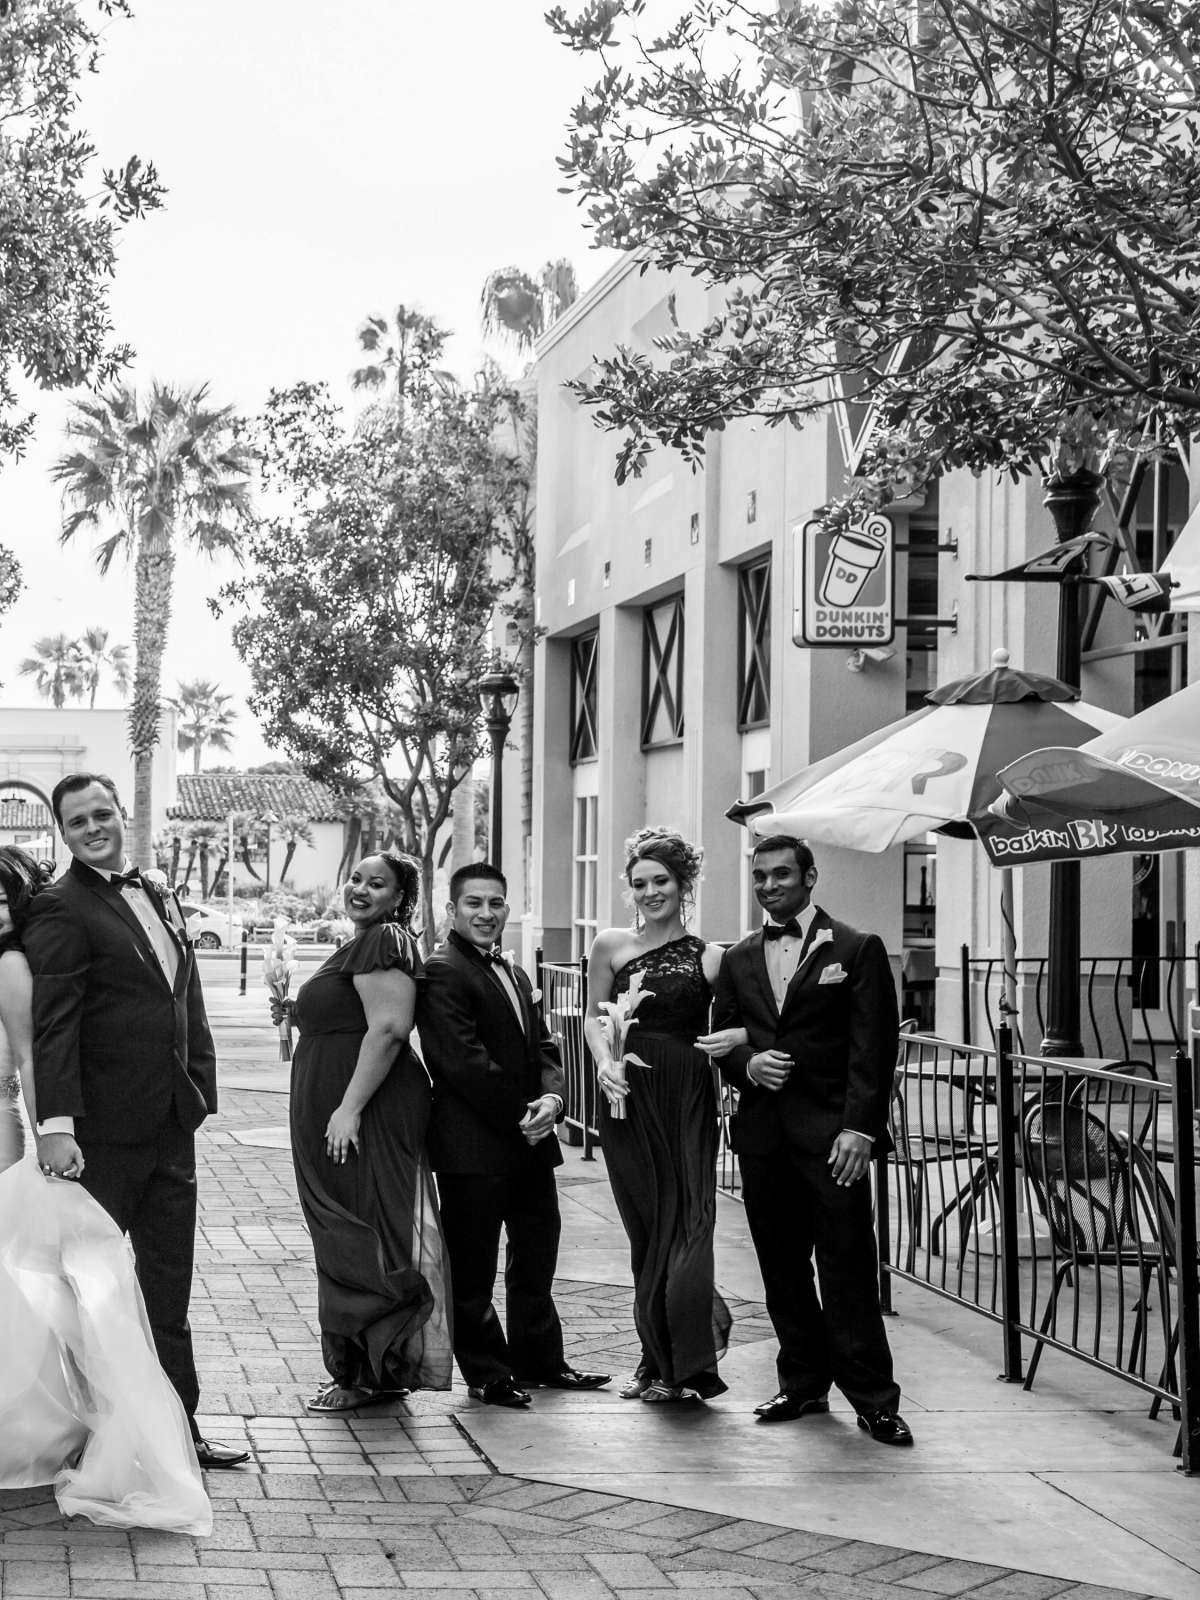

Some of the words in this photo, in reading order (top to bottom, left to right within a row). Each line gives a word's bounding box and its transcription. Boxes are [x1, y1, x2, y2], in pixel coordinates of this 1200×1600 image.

[835, 566, 858, 583] DD
[815, 610, 888, 624] DUNKIN'
[815, 625, 885, 638] DONUTS
[989, 829, 1070, 856] baskin
[1067, 819, 1117, 850] BR
